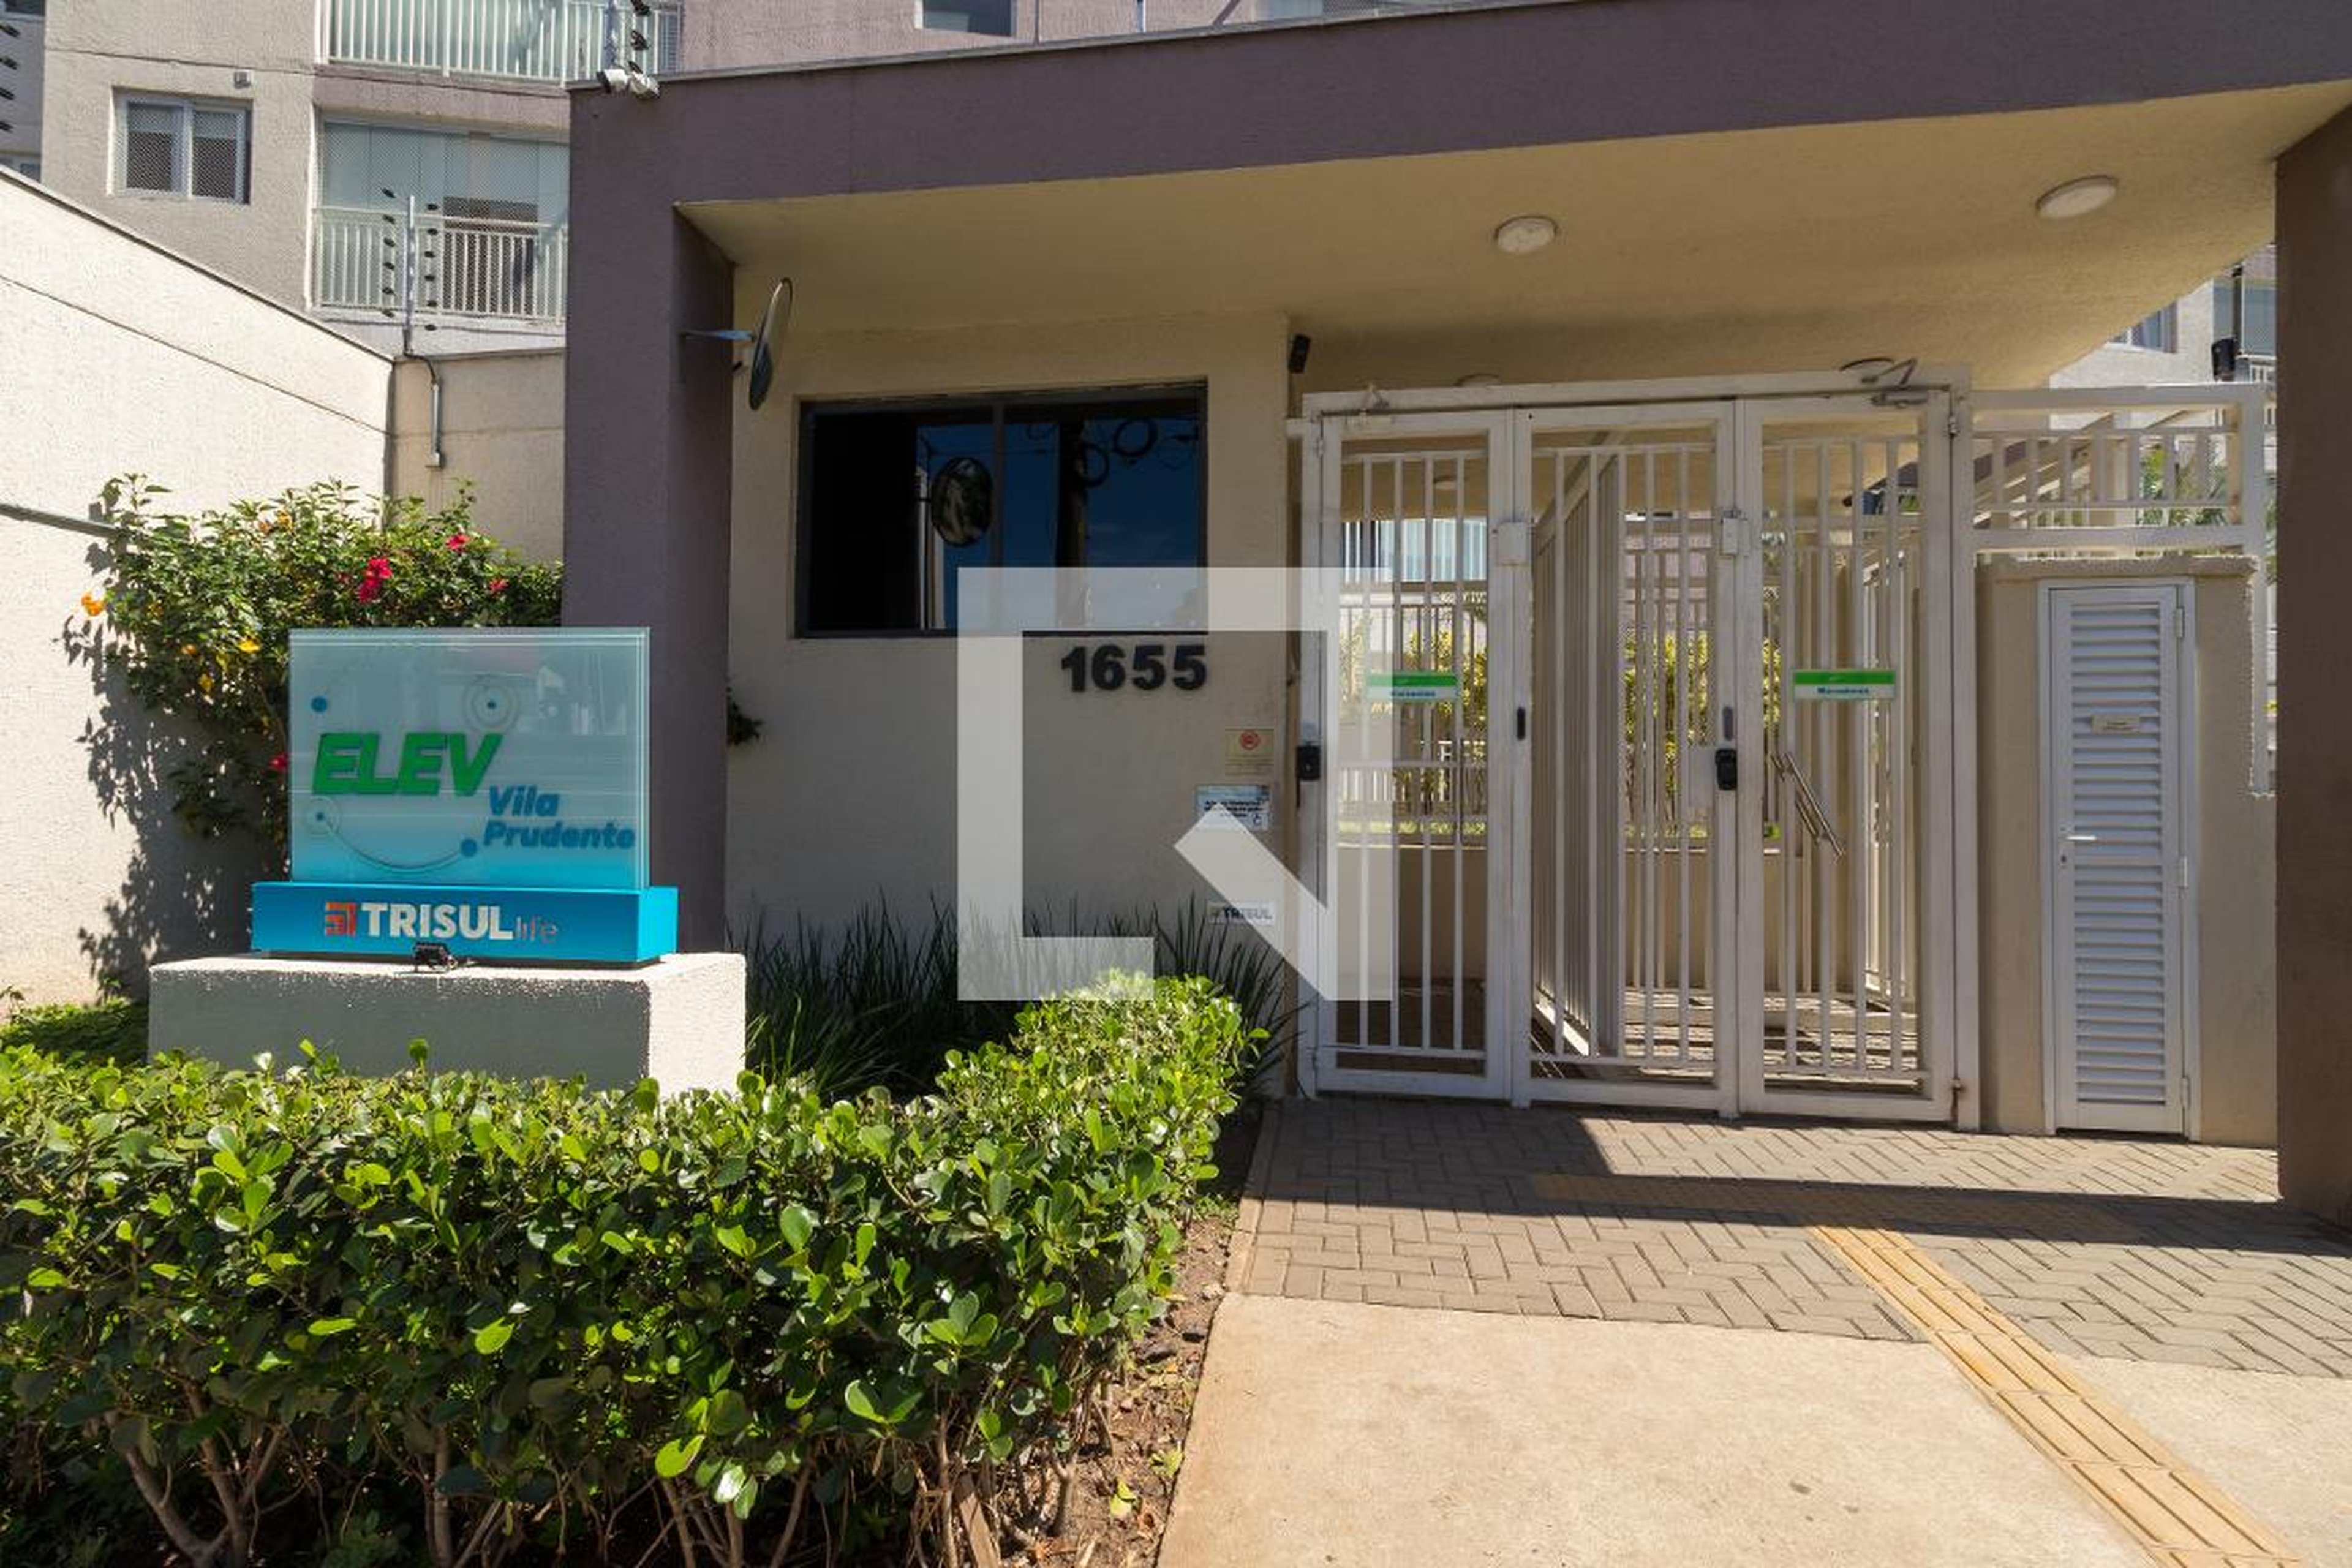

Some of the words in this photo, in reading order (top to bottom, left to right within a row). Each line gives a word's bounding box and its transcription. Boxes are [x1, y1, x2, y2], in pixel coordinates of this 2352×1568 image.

[1061, 645, 1207, 692] 1655
[312, 732, 505, 796] ELEV
[489, 785, 560, 817] Vila
[483, 821, 635, 850] Prudente
[361, 902, 513, 940] TRISUL
